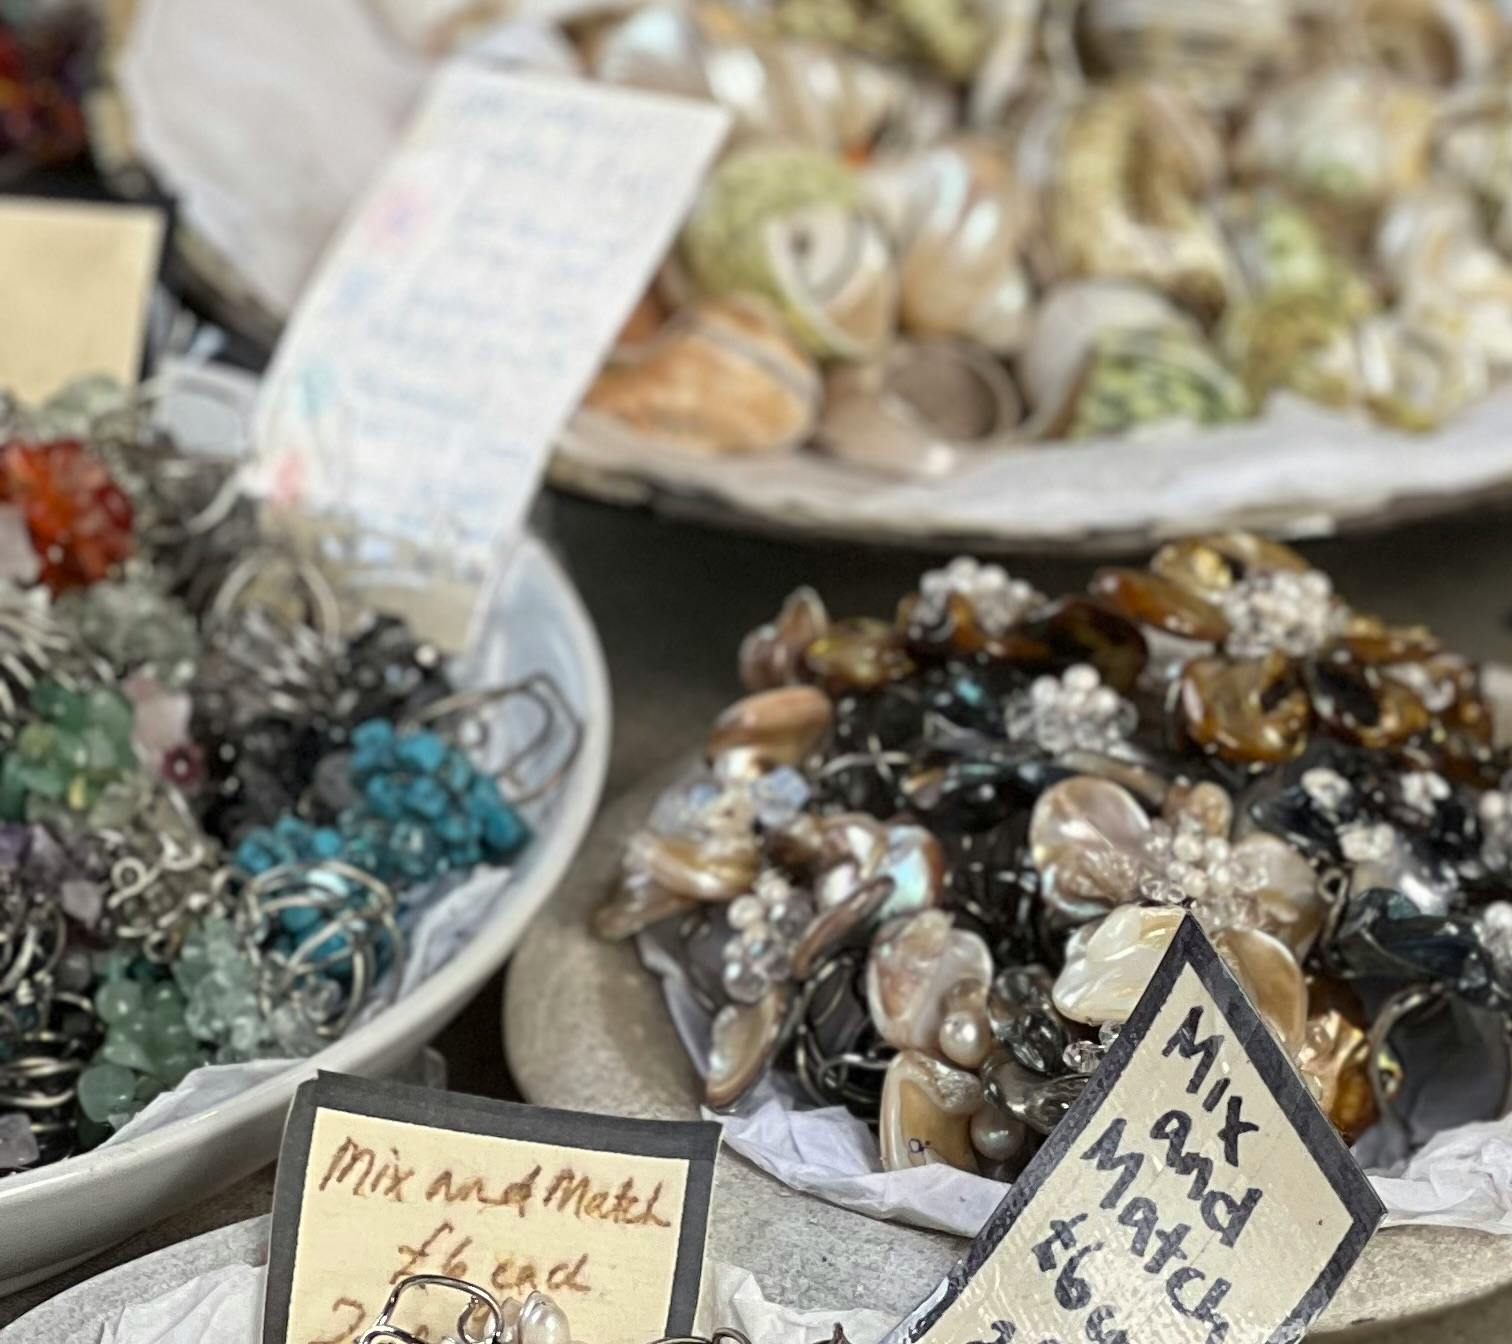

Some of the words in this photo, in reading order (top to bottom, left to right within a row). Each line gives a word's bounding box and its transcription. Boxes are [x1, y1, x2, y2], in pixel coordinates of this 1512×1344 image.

[318, 1136, 416, 1203] Mix
[424, 1164, 543, 1219] and
[541, 1166, 673, 1229] Match
[1149, 1109, 1264, 1249] and
